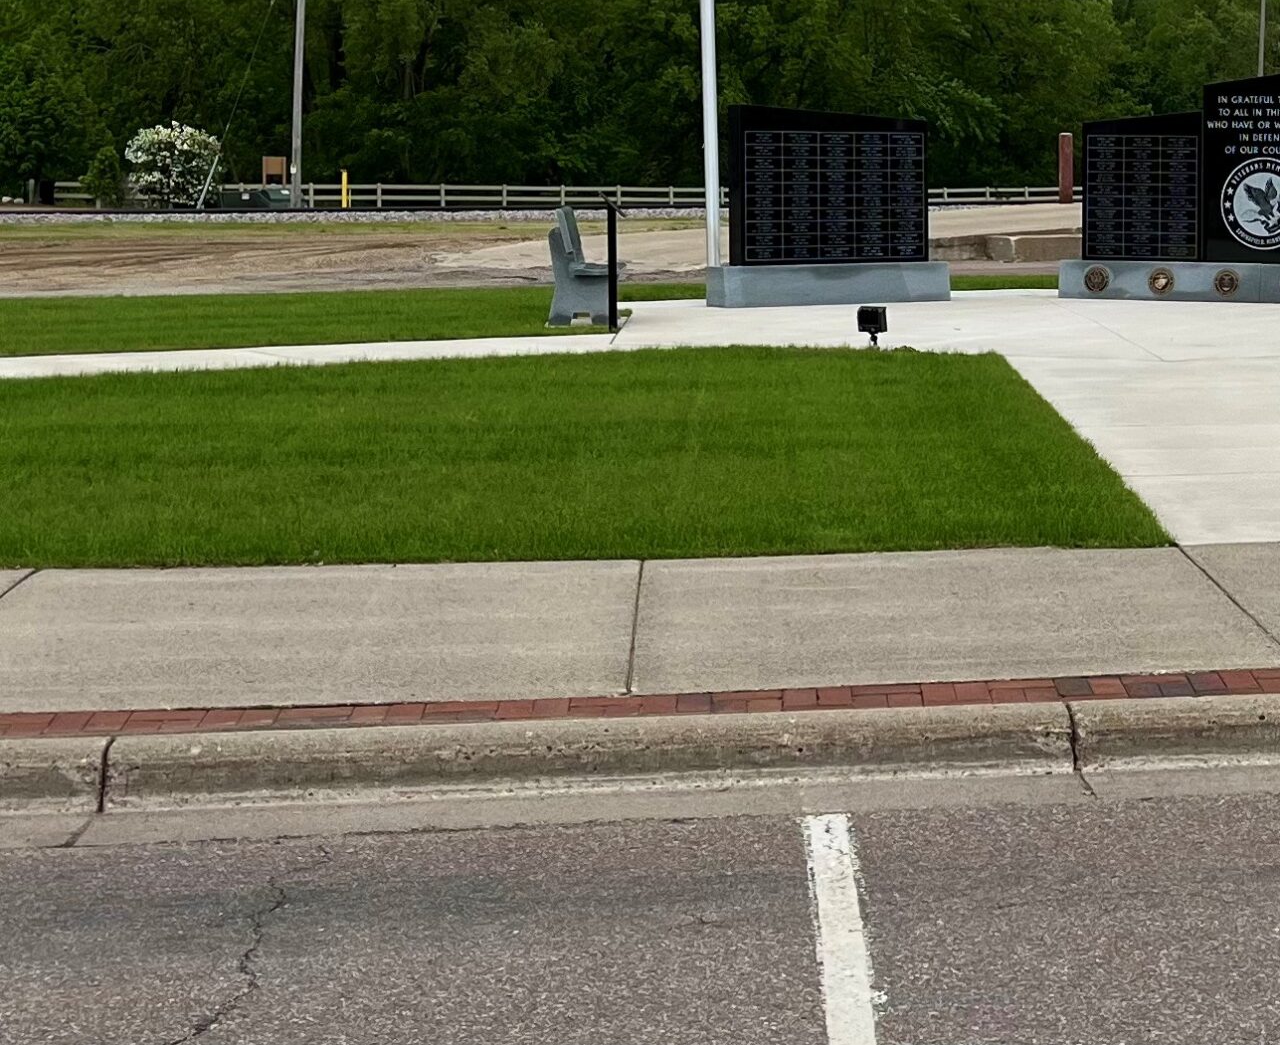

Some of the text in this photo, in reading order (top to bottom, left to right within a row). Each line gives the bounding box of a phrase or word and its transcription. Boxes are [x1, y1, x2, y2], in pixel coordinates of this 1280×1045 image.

[1218, 96, 1228, 104] IN
[1231, 96, 1274, 104] GRATEFUL
[1218, 108, 1230, 116] TO
[1207, 121, 1228, 129] WHO
[1232, 121, 1253, 129] HAVE
[1258, 121, 1270, 129] OR
[1225, 146, 1236, 154] OF
[1240, 146, 1259, 154] OUR
[1231, 162, 1263, 184] VETERANS
